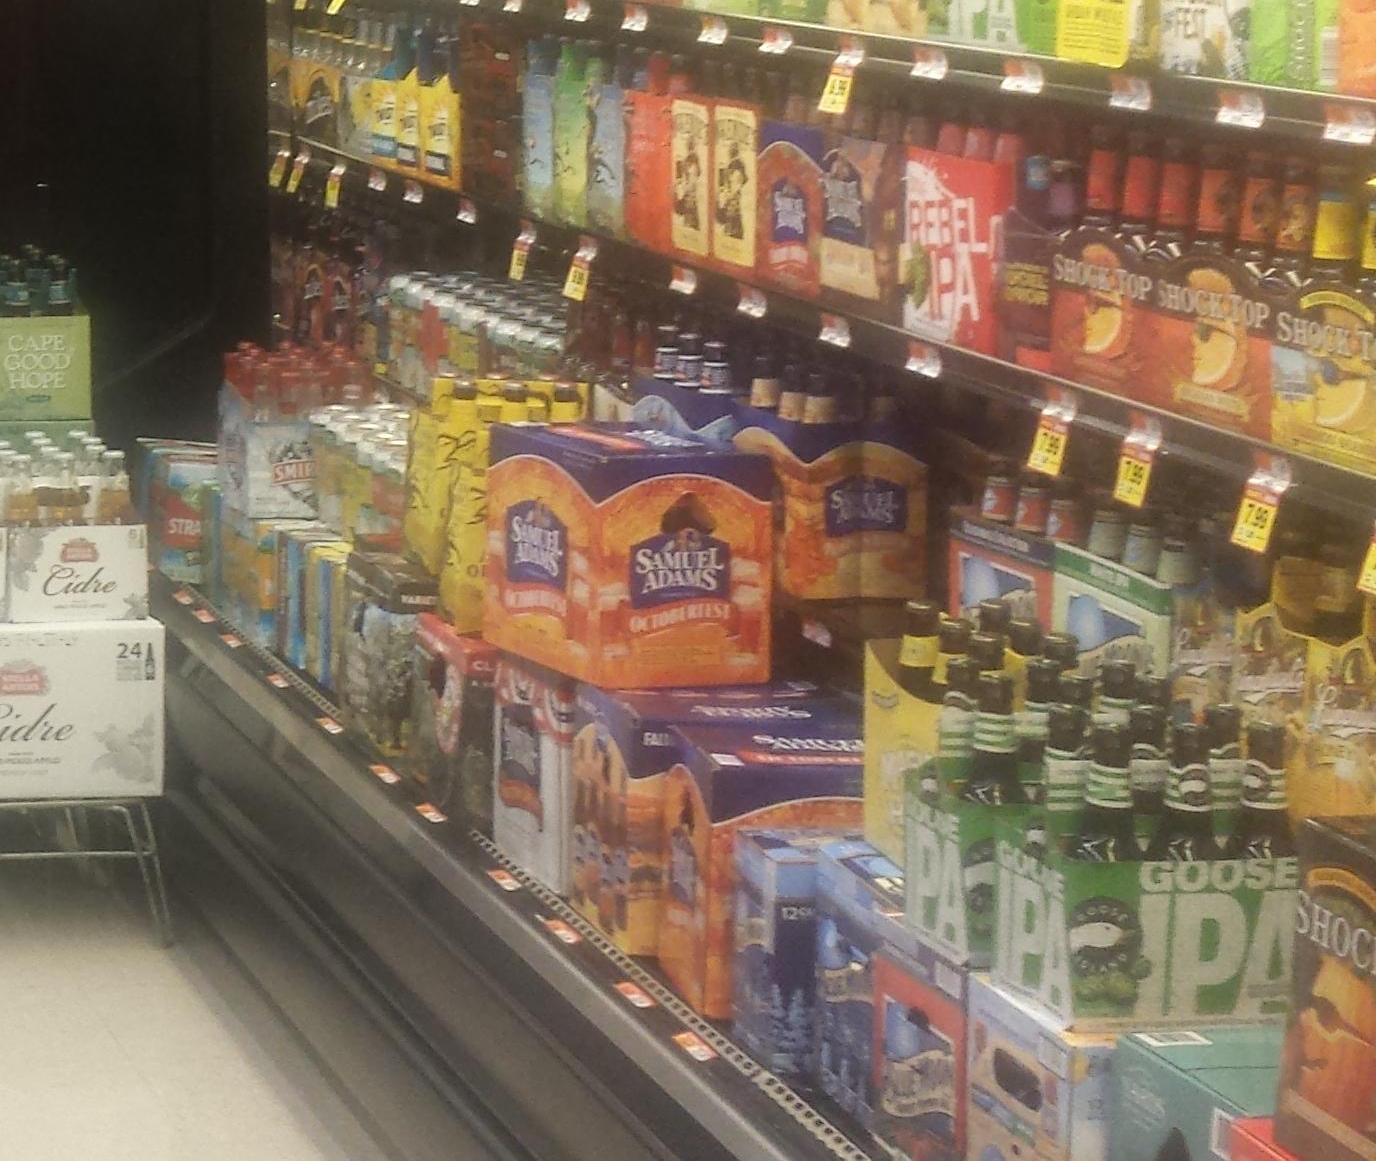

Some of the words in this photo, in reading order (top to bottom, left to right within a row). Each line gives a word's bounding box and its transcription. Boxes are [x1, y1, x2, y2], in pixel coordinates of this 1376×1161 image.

[1053, 253, 1116, 296] SHOCK
[1116, 272, 1153, 303] TOP
[1157, 279, 1229, 322] SHOCK
[1229, 293, 1271, 329] TOP
[8, 334, 66, 352] CAPE
[1276, 311, 1350, 357] SHOCK
[4, 353, 71, 371] GOOD
[8, 371, 66, 390] HOPE
[511, 515, 564, 557] SAMUEL
[514, 541, 560, 578] ADAMS
[635, 547, 725, 575] SAMUEL
[43, 564, 118, 597] Cidre
[641, 568, 717, 595] ADAMS
[116, 642, 143, 660] 24
[1139, 857, 1298, 893] GOOSE
[1296, 890, 1376, 975] SHOC
[1136, 889, 1300, 1019] IPA
